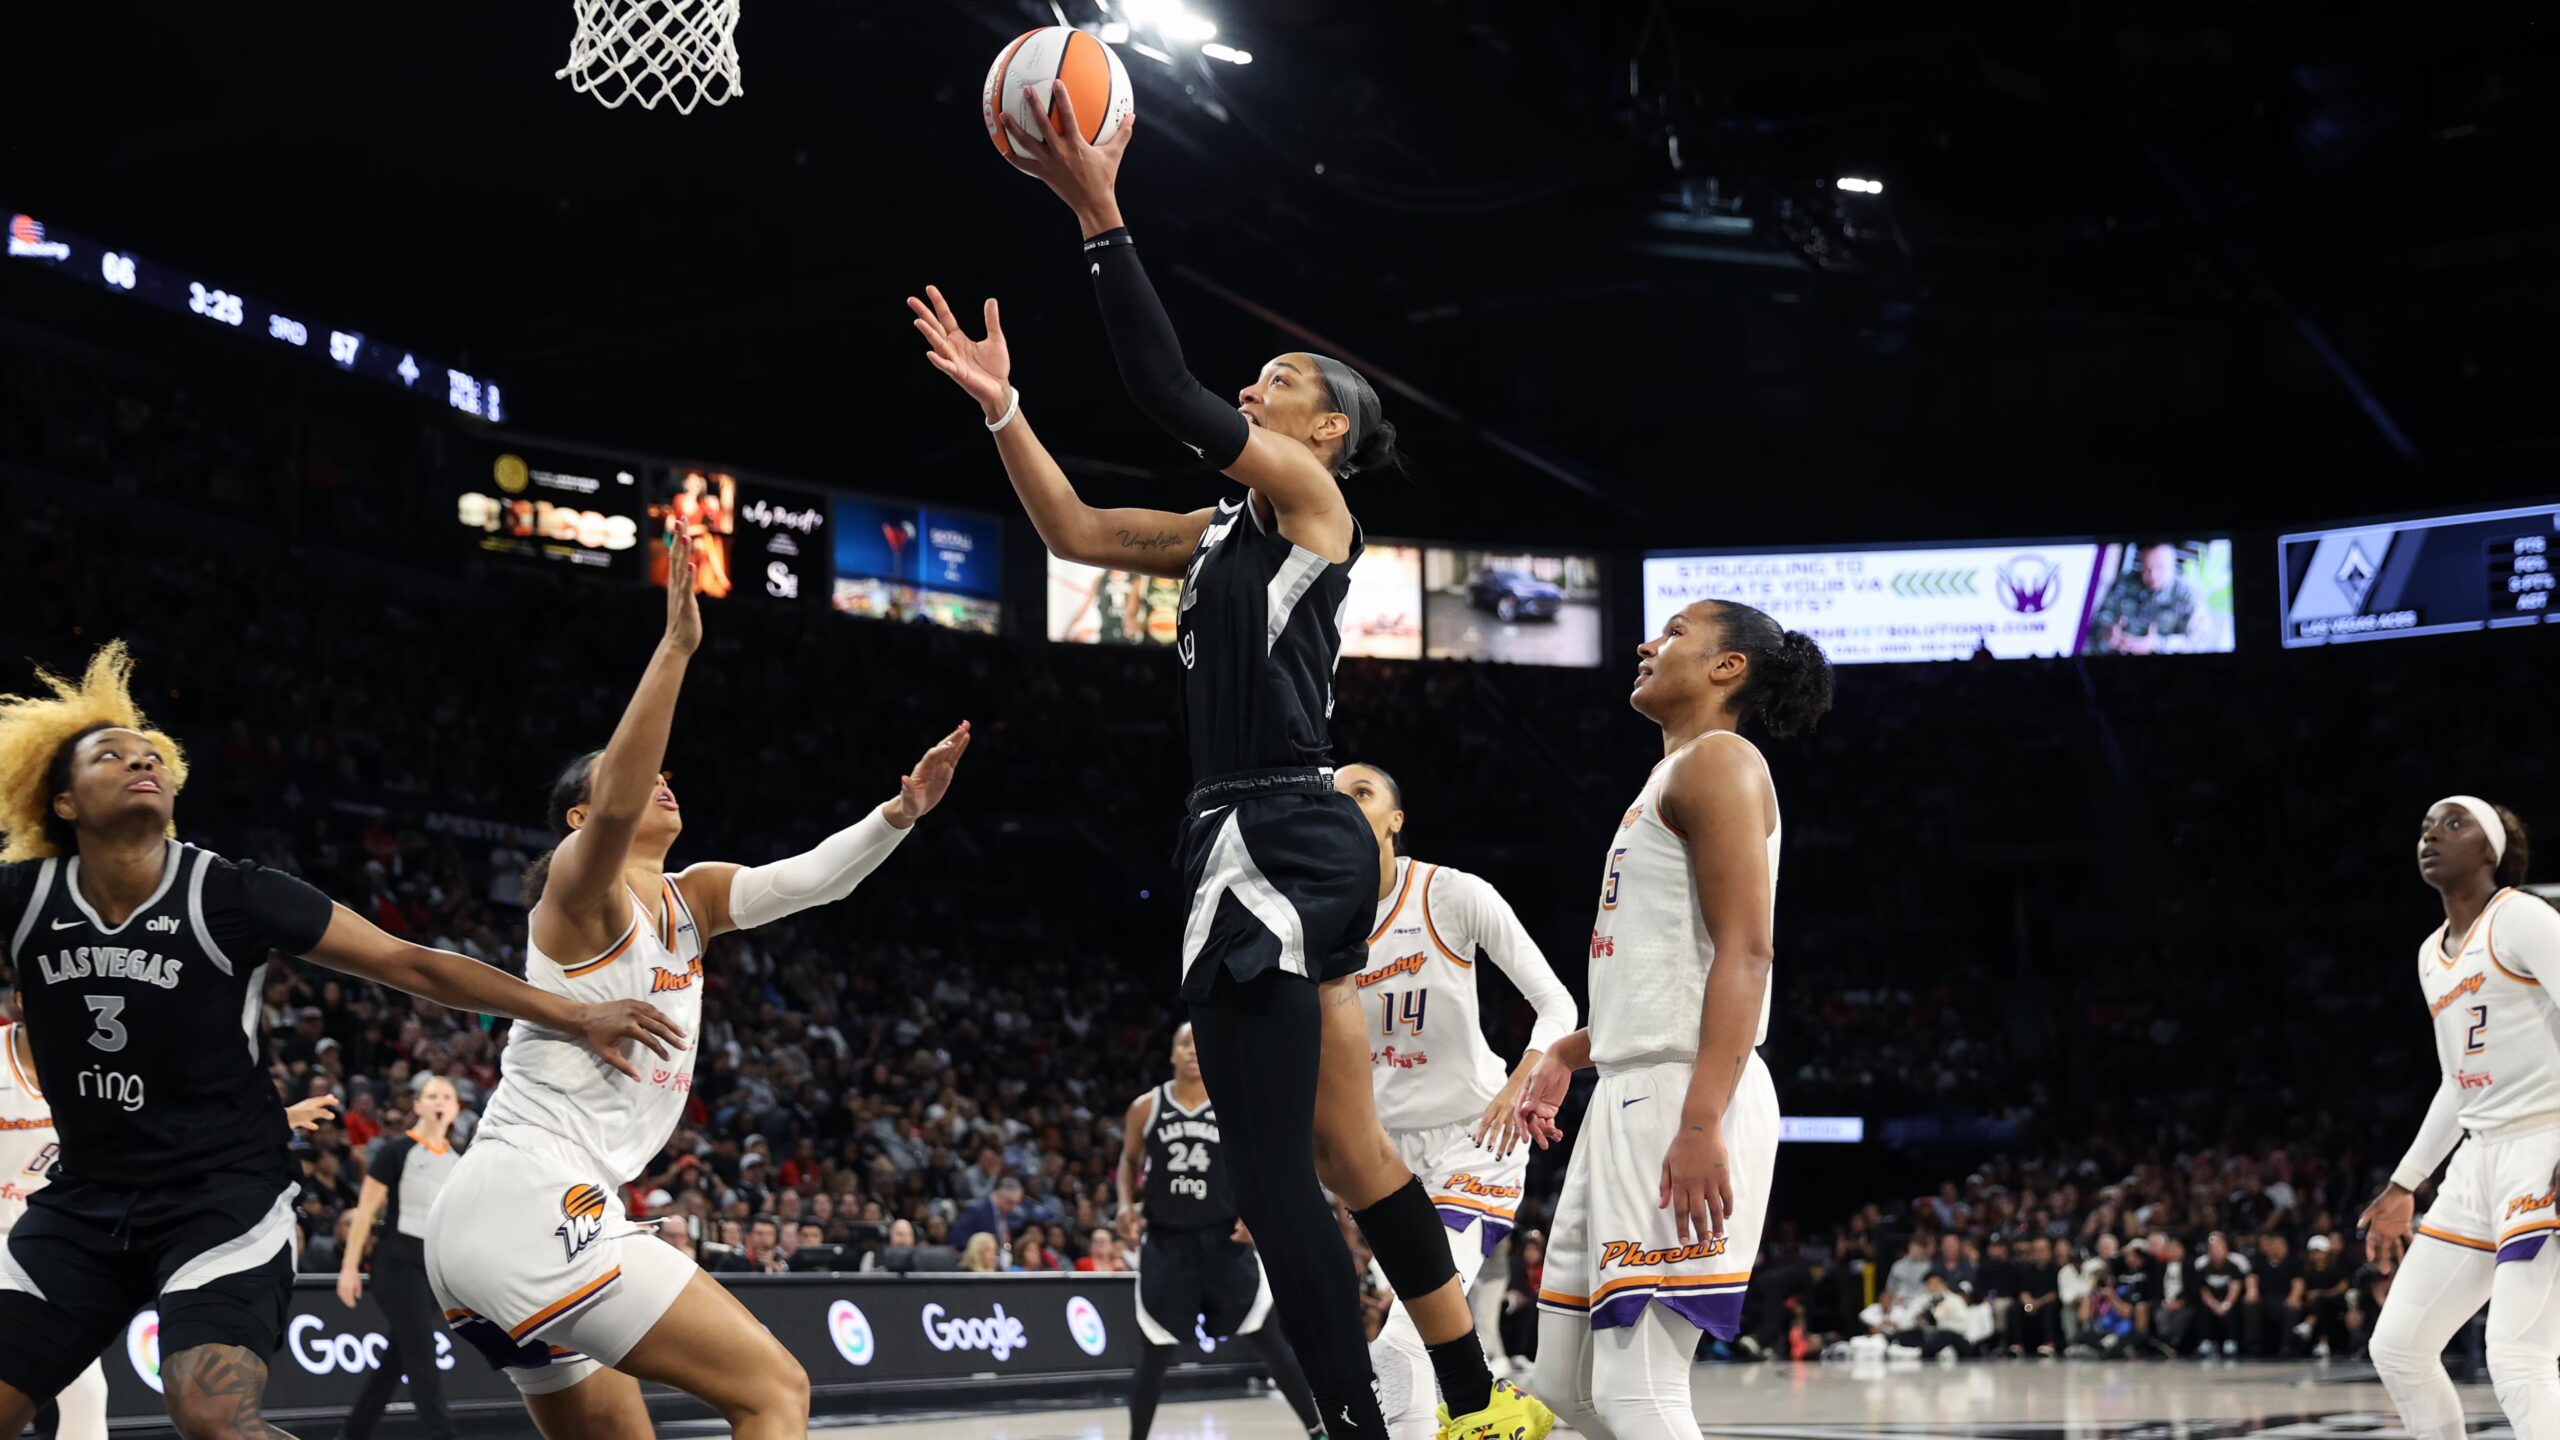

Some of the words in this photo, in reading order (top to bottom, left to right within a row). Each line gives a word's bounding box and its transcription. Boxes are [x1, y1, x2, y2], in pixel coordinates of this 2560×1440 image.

[189, 282, 243, 326] 3:25
[330, 331, 359, 365] 57
[1657, 582, 1773, 598] NAVIGATE
[1780, 578, 1845, 594] YOUR
[1852, 577, 1883, 592] VA
[1677, 560, 1826, 577] STRUGGLING
[1835, 558, 1865, 573] TO
[1601, 848, 1629, 911] 5
[146, 915, 181, 935] ally
[37, 948, 92, 985] LAS
[91, 946, 184, 989] VEGAS
[1355, 951, 1428, 989] rcury
[84, 994, 128, 1052] 3
[1378, 988, 1428, 1036] 14
[2464, 1004, 2488, 1056] 2
[78, 1064, 144, 1112] ring
[1167, 1142, 1211, 1173] 24
[1170, 1175, 1208, 1200] ring
[1443, 1172, 1522, 1199] Phoeni
[1600, 1231, 1729, 1271] Phoenix
[288, 1314, 455, 1384] Gooe
[922, 1302, 1028, 1362] Google
